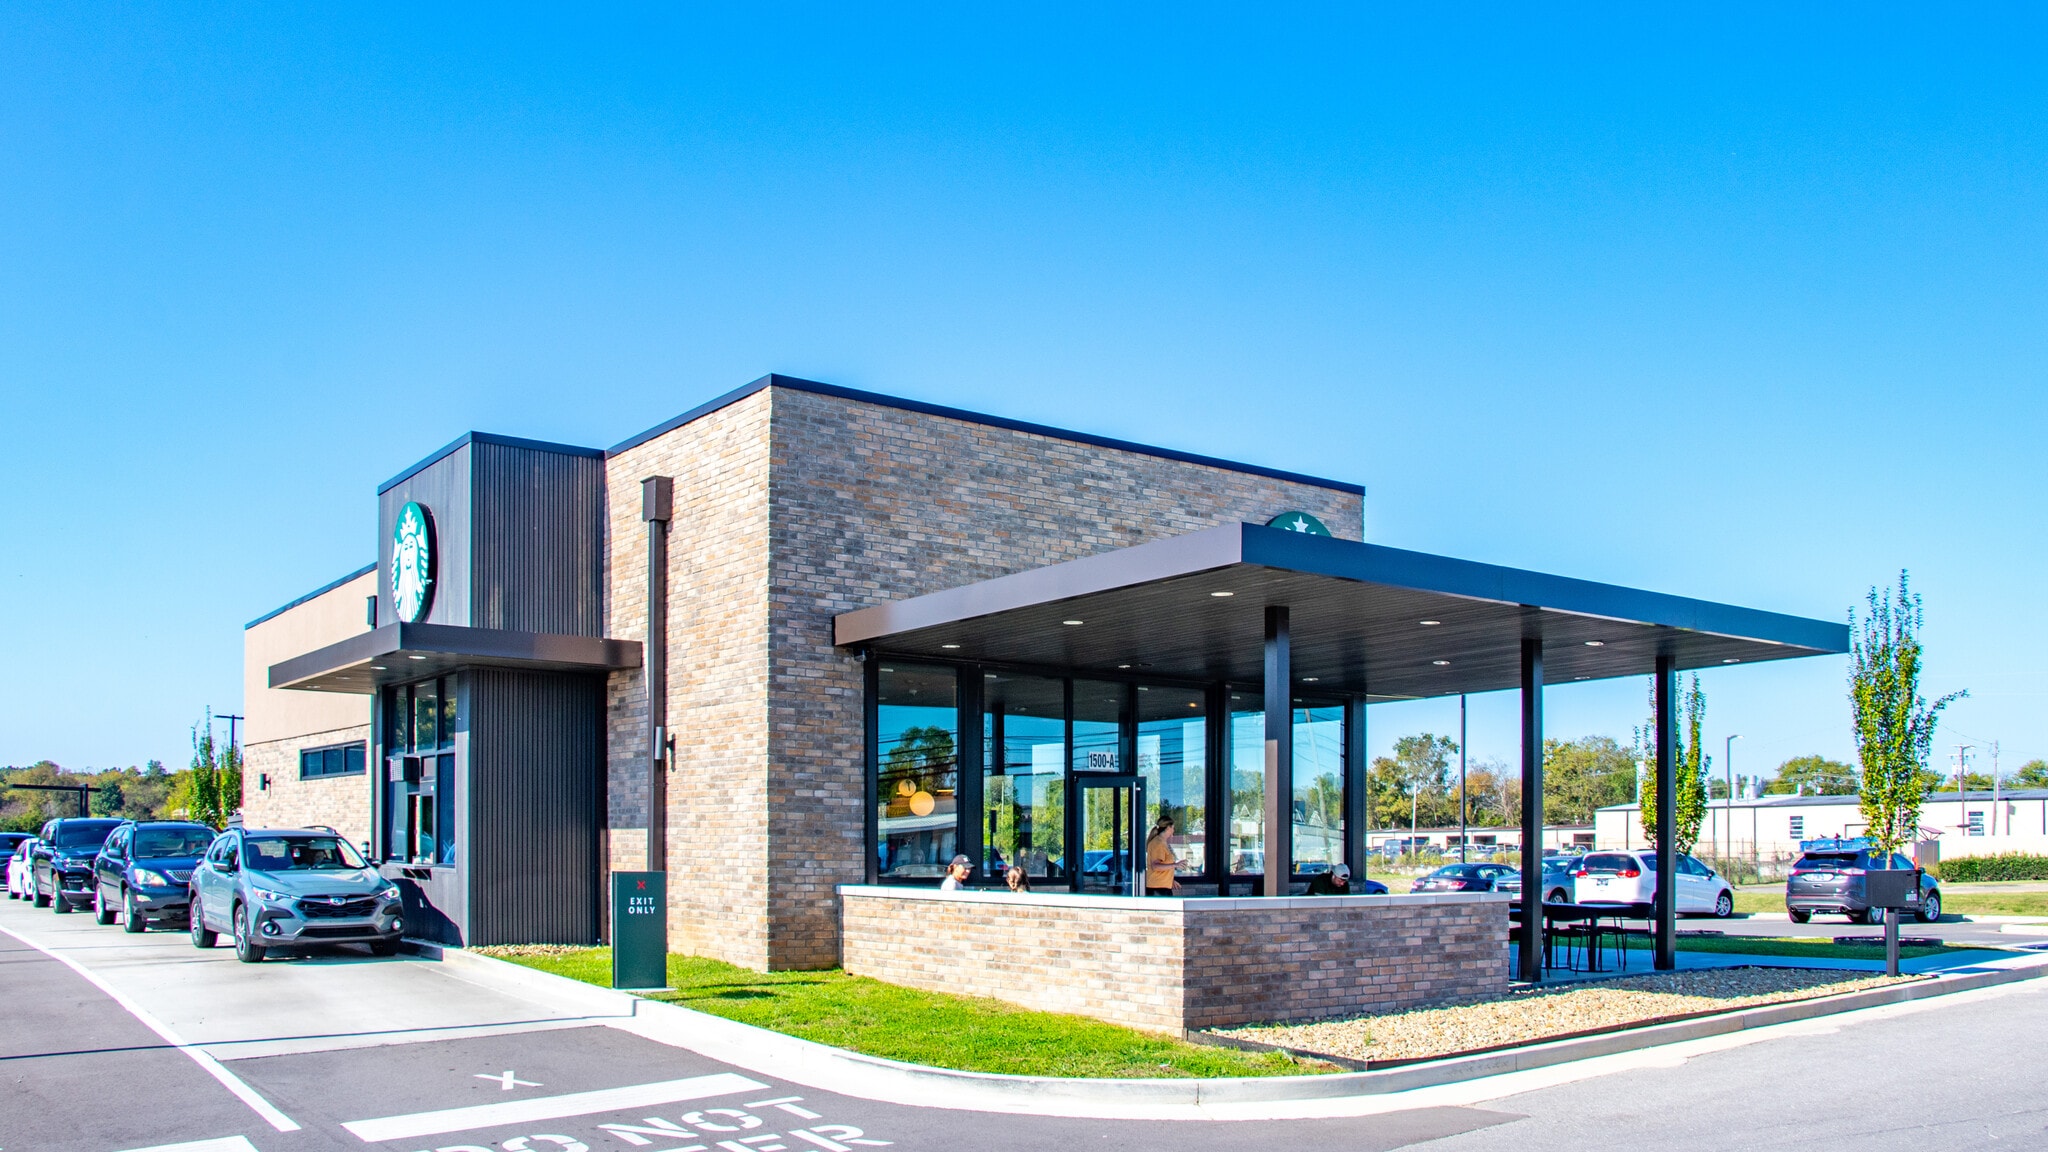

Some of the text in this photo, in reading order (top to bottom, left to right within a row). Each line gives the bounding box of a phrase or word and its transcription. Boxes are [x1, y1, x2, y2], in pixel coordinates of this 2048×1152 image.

[1089, 752, 1115, 769] 1500-A
[630, 897, 654, 905] EXIT
[628, 906, 656, 914] ONLY
[412, 1096, 823, 1152] O NOT
